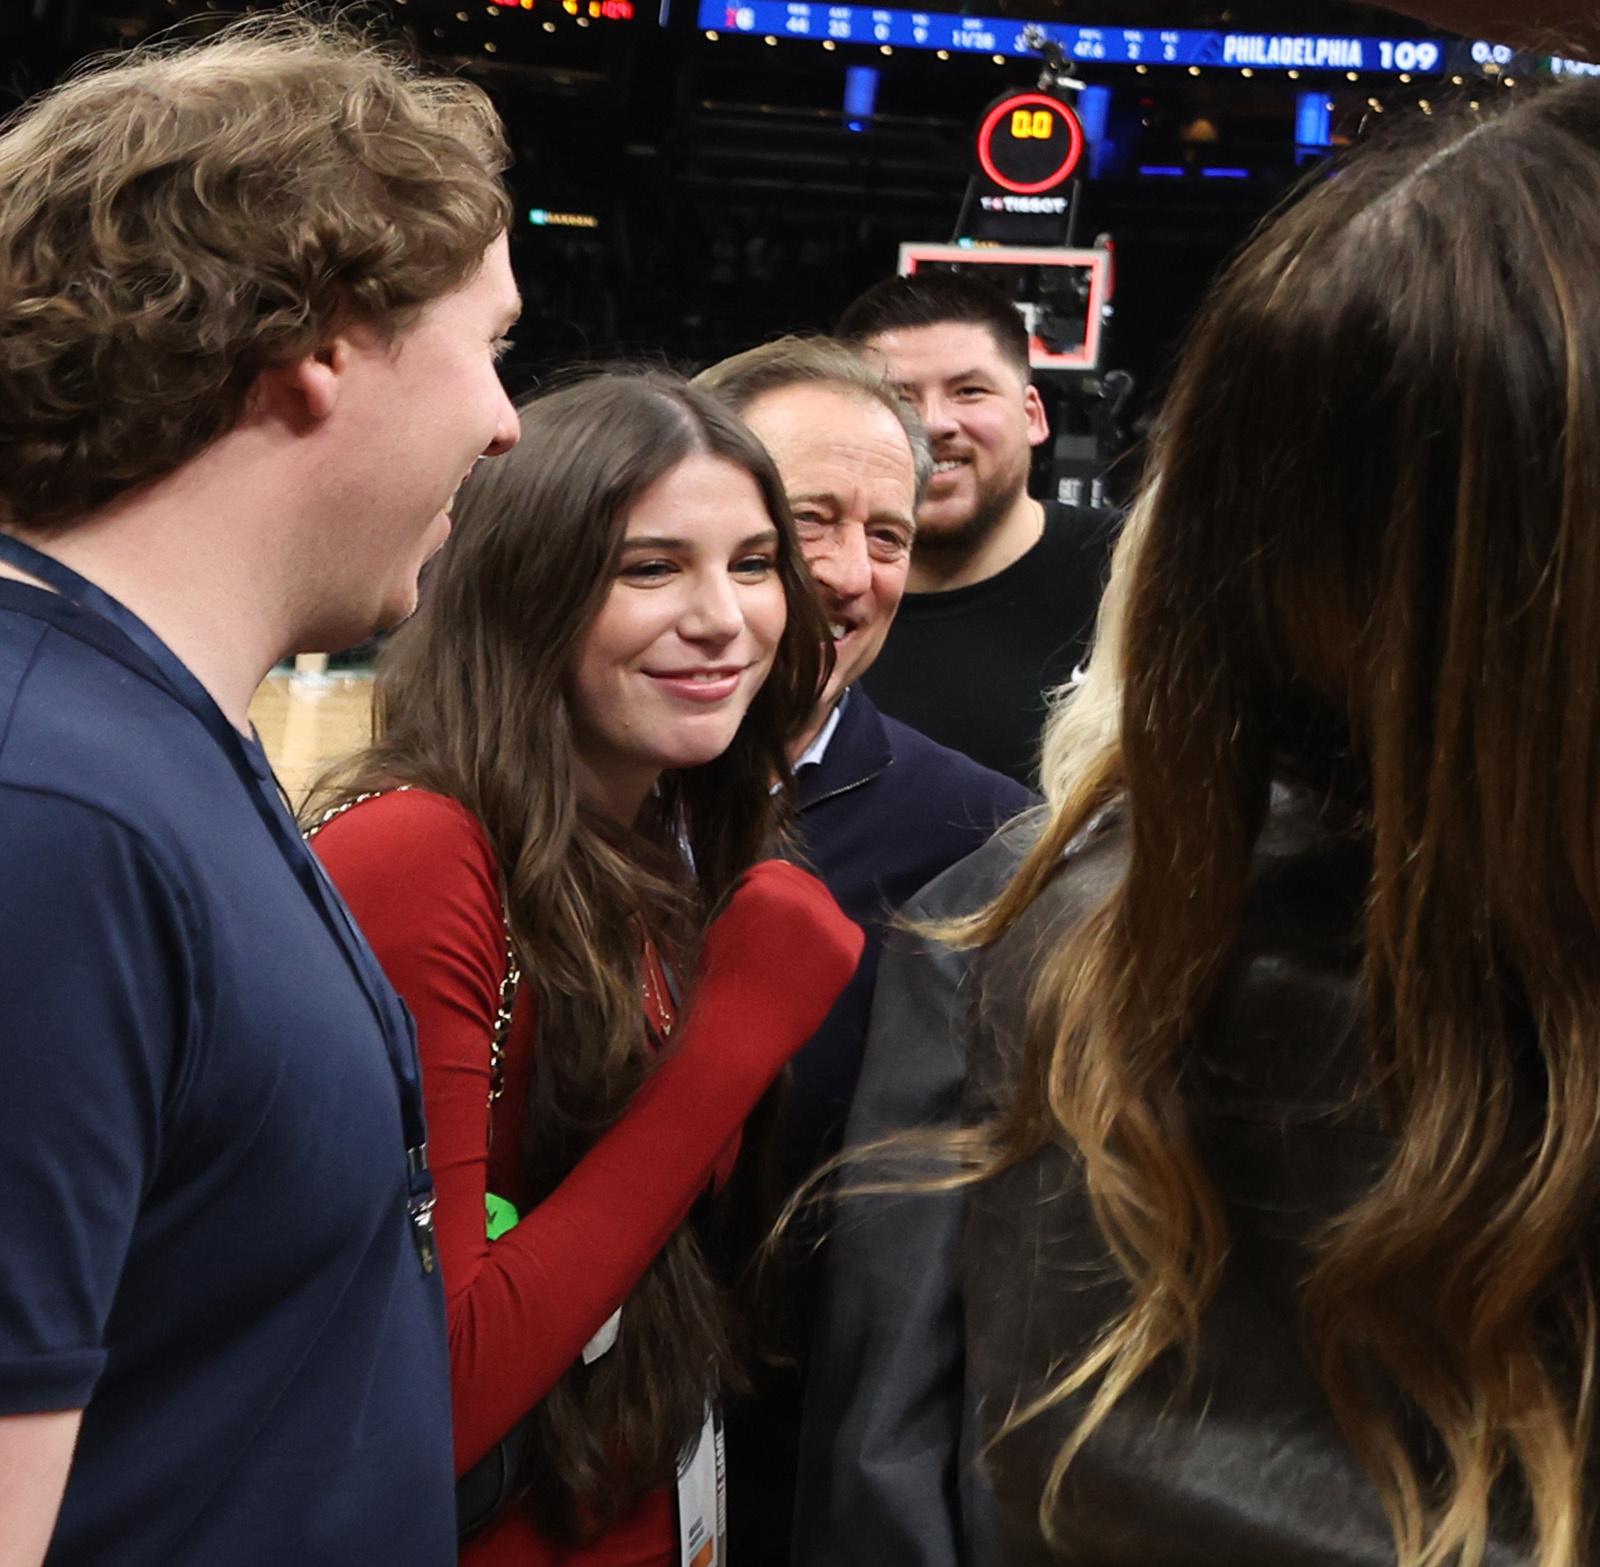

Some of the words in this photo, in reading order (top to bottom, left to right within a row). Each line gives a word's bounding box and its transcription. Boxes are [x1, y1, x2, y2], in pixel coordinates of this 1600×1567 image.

[1223, 35, 1363, 68] PHILADELPHIA
[1379, 41, 1429, 71] 109
[1002, 195, 1068, 214] TISSOT
